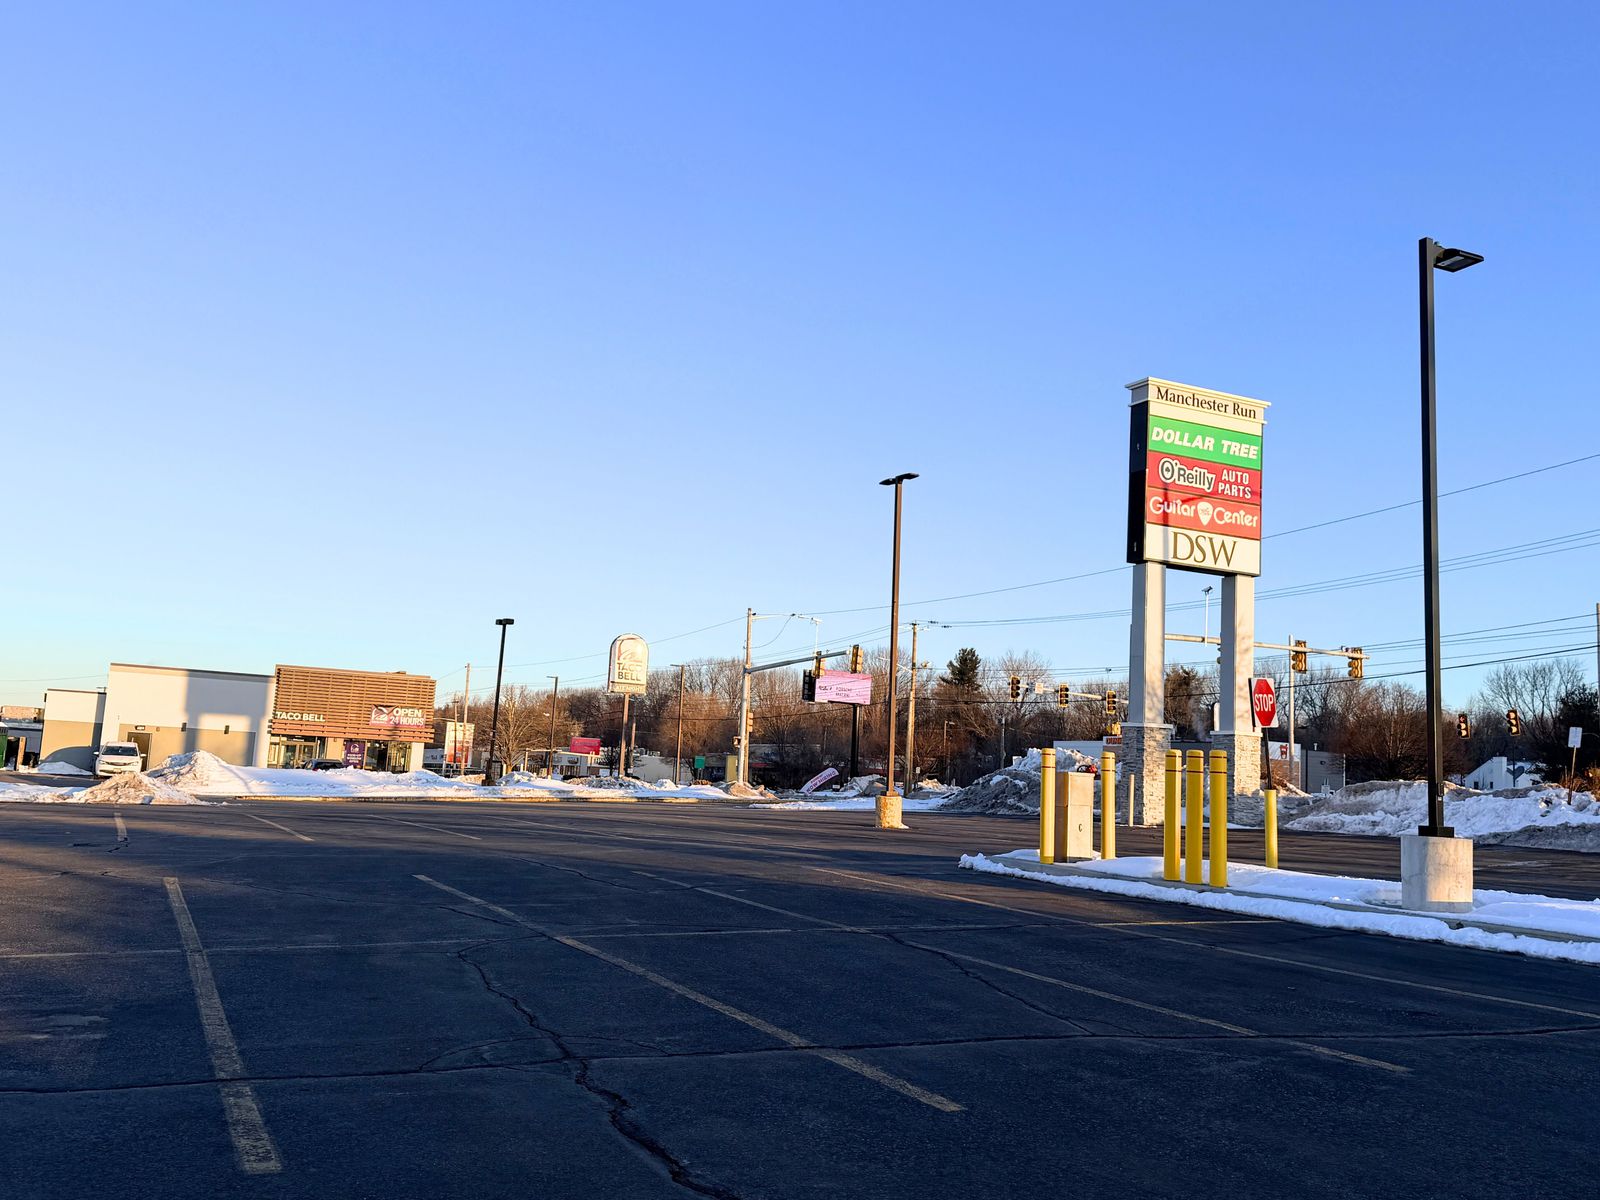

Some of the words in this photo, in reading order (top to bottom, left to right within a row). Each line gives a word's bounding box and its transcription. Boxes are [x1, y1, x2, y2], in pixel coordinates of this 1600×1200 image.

[1156, 386, 1229, 413] Manchester
[1233, 402, 1257, 419] Run
[1151, 426, 1215, 451] DOLLAR
[1221, 440, 1259, 459] TREE
[1159, 458, 1215, 491] O'Reilly
[1222, 469, 1249, 484] AUTO
[1218, 482, 1252, 499] PARTS
[1149, 496, 1196, 517] Guitar
[1213, 507, 1258, 527] Center
[1171, 531, 1238, 567] DSW
[617, 672, 641, 681] BELL
[1254, 694, 1274, 712] STOP
[275, 711, 301, 720] TACO
[302, 713, 326, 722] BELL
[390, 715, 400, 725] 24
[400, 717, 425, 726] HOURS
[393, 707, 422, 718] OPEN
